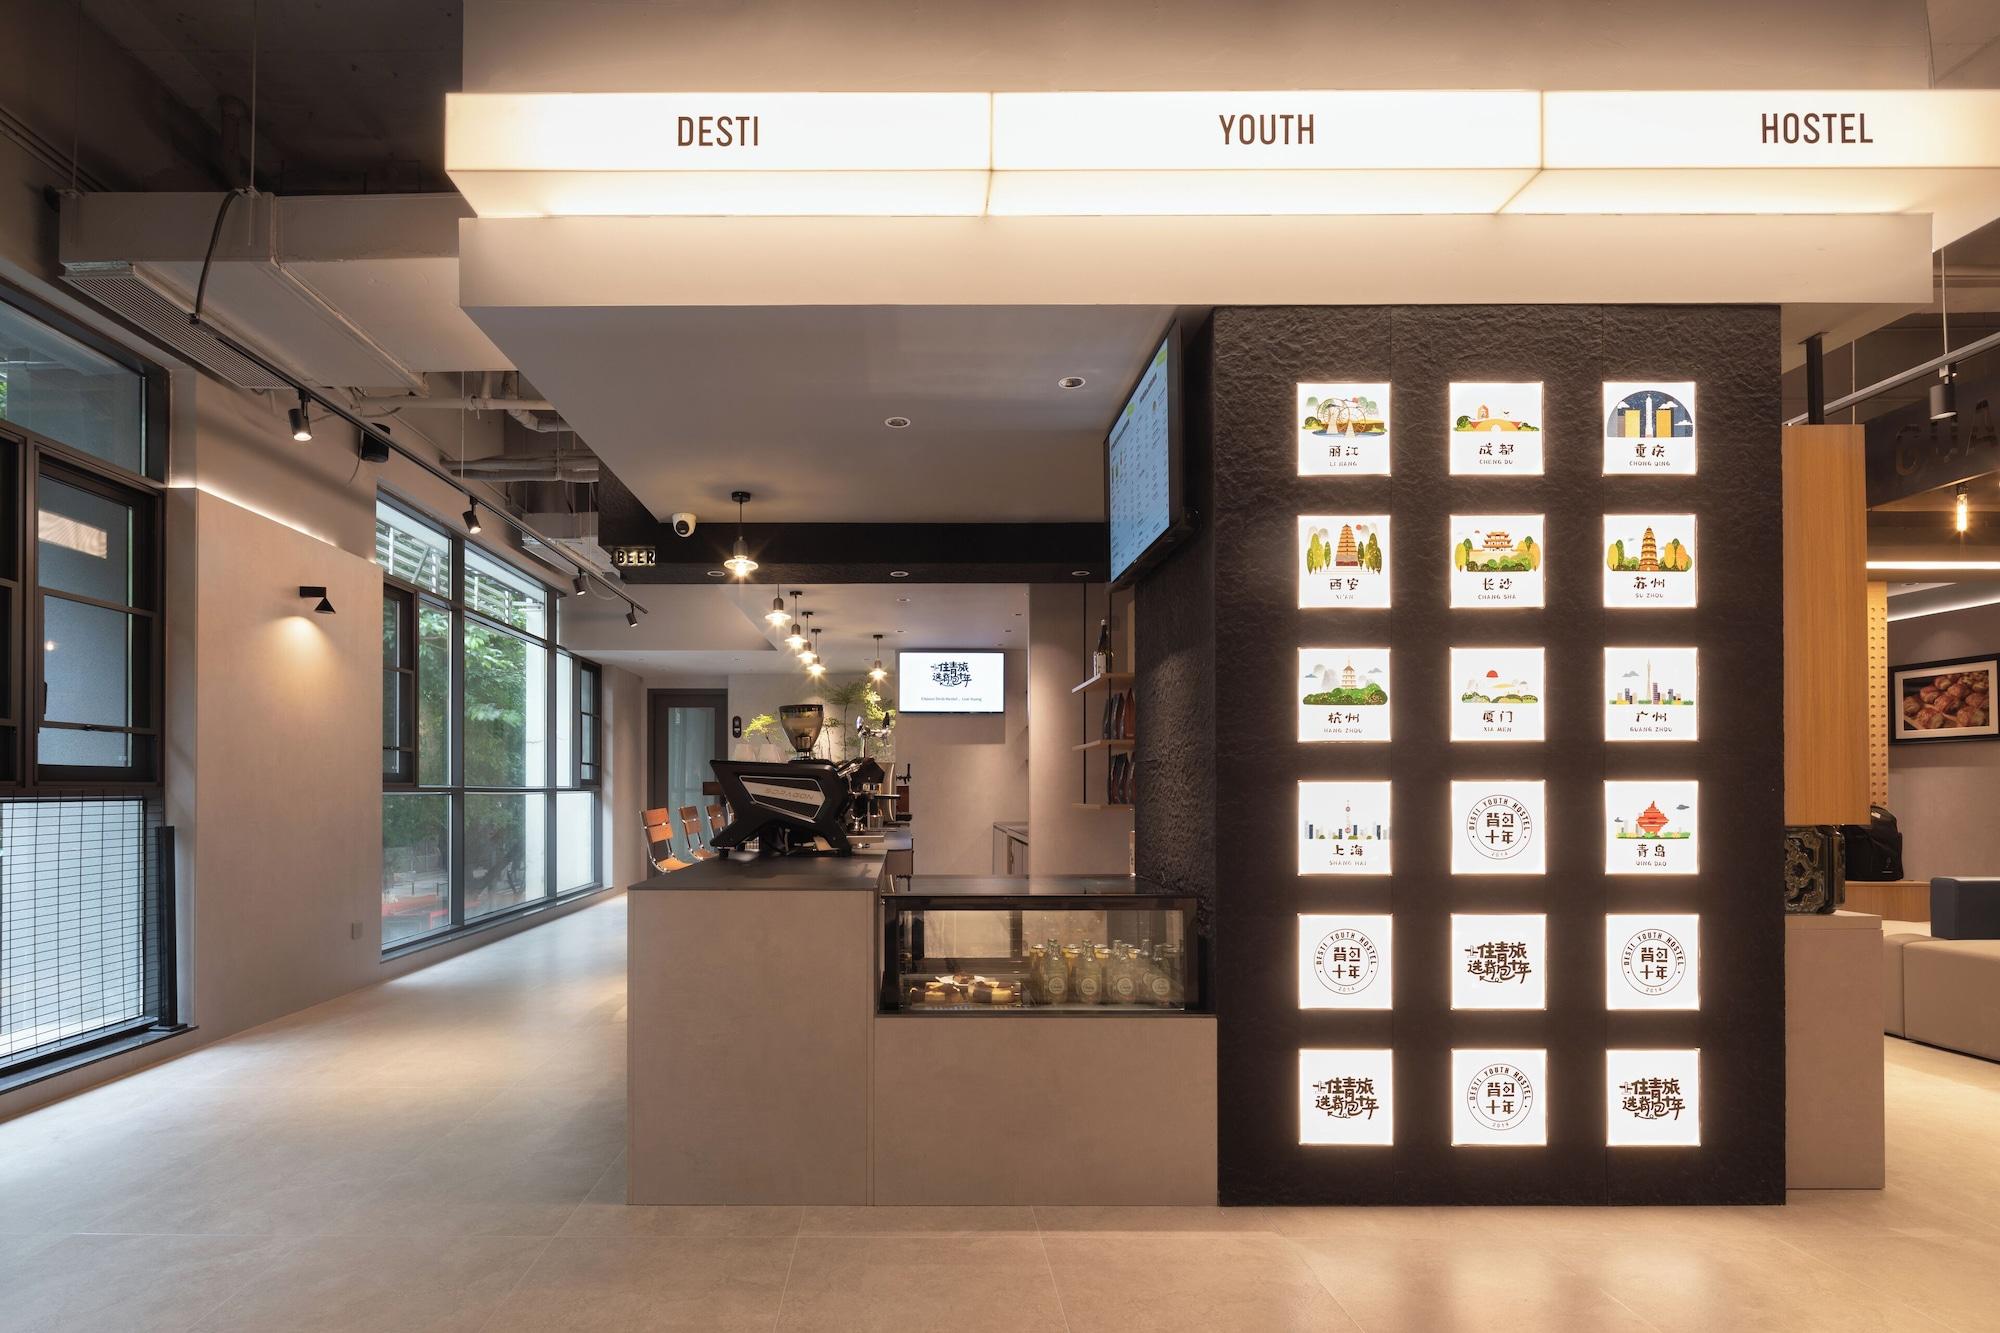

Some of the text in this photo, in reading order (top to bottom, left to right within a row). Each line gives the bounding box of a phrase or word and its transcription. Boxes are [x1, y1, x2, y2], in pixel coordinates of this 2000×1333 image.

[677, 112, 1874, 148] DESTI YOUTH HOSTEL
[1328, 445, 1360, 458] 丽江
[1478, 442, 1515, 457] 成都
[1634, 443, 1665, 459] 重庆
[617, 550, 656, 565] BEER
[1329, 577, 1359, 592] 西安
[1482, 577, 1513, 592] 长沙
[1633, 575, 1666, 590] 苏州
[1477, 593, 1517, 601] CHANG SHA
[1327, 711, 1360, 725] 杭州
[1482, 709, 1513, 724] 厦门
[1635, 710, 1667, 723] 广州
[1469, 797, 1531, 831] DESTI YOUTH HOSTEL
[1331, 843, 1364, 857] 上海
[1636, 842, 1666, 859] 青岛
[1316, 931, 1377, 965] DESTI YOUTH HOSTEL
[1623, 931, 1685, 966] DESTI YOUTH HOSTEL
[1467, 959, 1532, 984] 选背包十年
[1469, 1066, 1532, 1101] DESTI YOUTH HOSTEL
[1315, 1094, 1380, 1120] 选背包十年
[1622, 1095, 1686, 1121] 选背包十年
